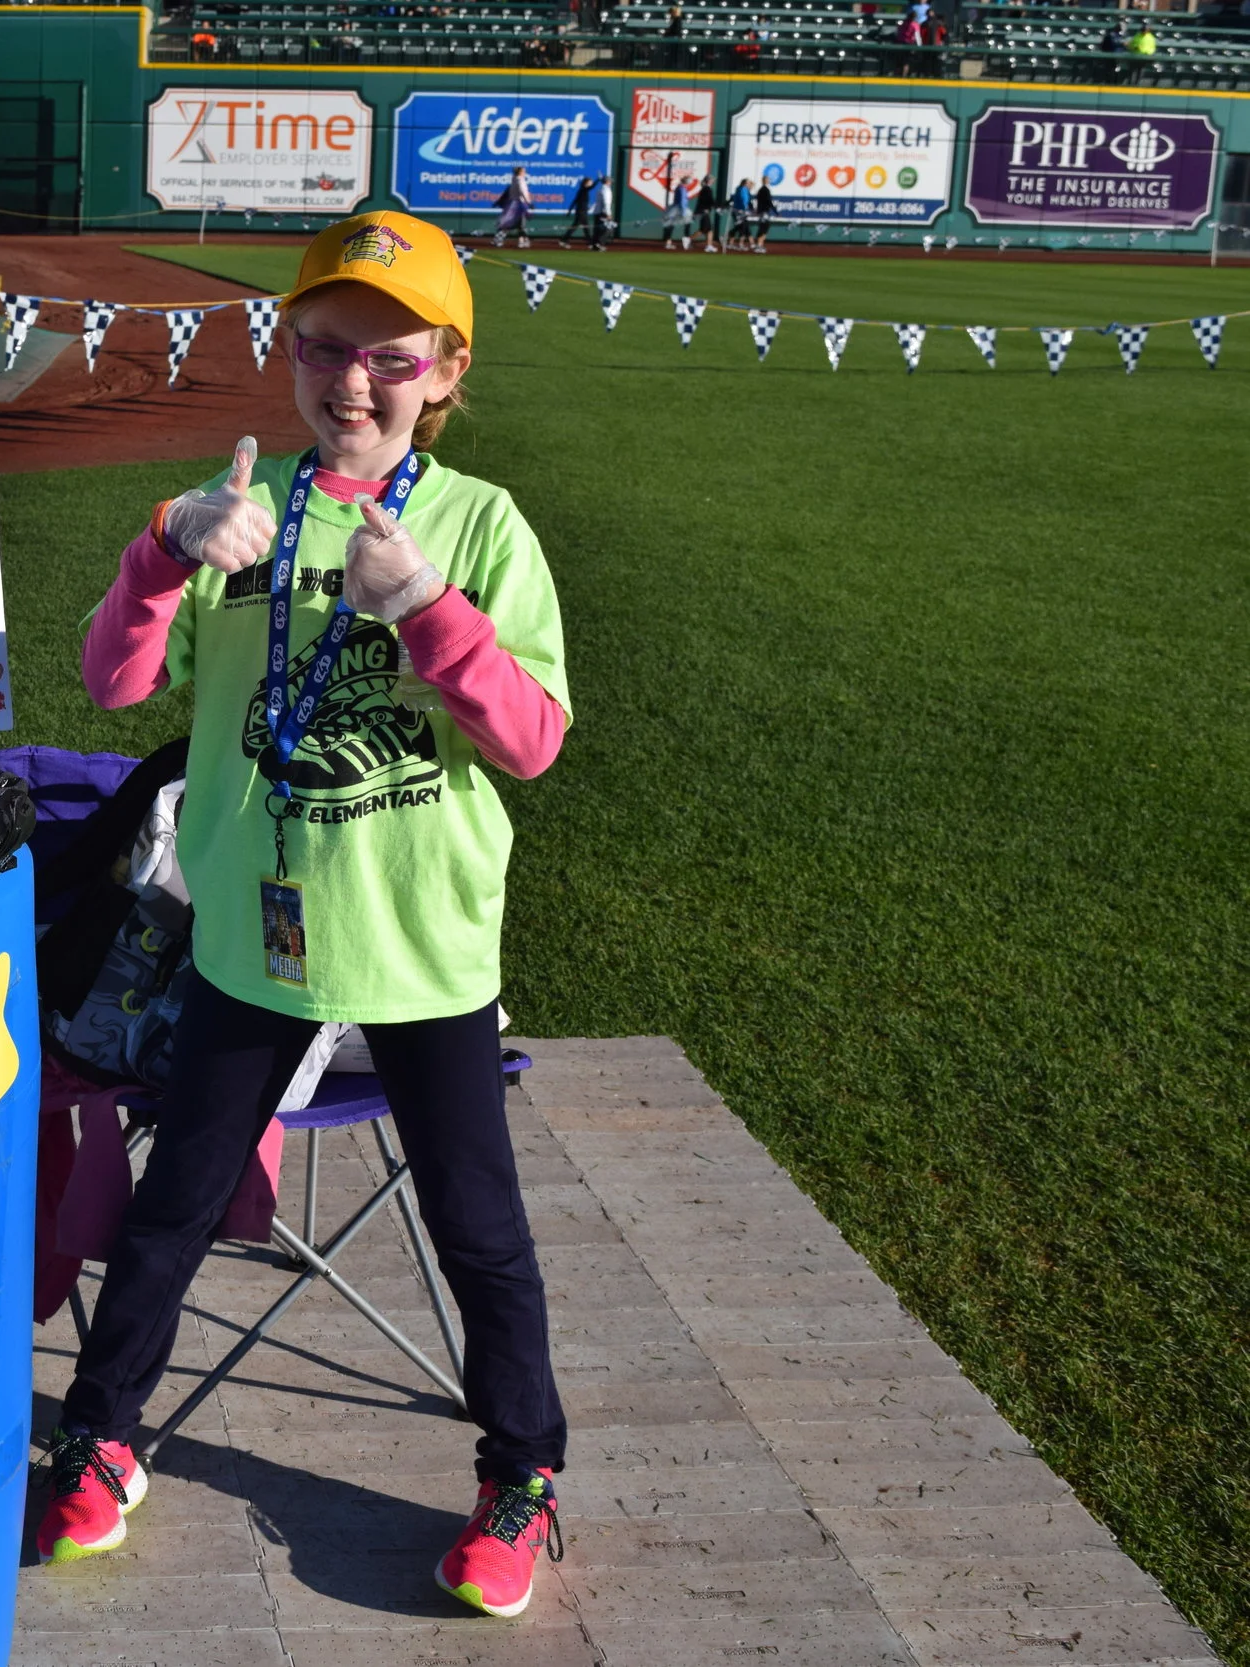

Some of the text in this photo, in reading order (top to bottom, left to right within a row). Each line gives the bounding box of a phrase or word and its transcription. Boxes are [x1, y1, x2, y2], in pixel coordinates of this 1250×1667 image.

[637, 94, 683, 125] 2009
[215, 100, 356, 151] Time
[435, 106, 589, 156] Afdent
[634, 131, 710, 146] CHAMPIONS
[1008, 120, 1107, 169] PHP
[219, 152, 352, 167] EMPLOYER SERVICES
[160, 178, 197, 187] OFFICIAL
[201, 178, 217, 188] PAY
[220, 179, 262, 188] SERVICES
[264, 179, 279, 189] OF
[280, 180, 296, 189] THE
[420, 171, 466, 184] Patient
[468, 172, 512, 185] Friendl
[1007, 176, 1172, 196] THE INSURANCE
[438, 190, 466, 201] Now
[1006, 193, 1170, 209] YOUR HEALTH DESERVES
[307, 784, 442, 824] ELEMENTARY
[269, 953, 303, 982] MEDIA
